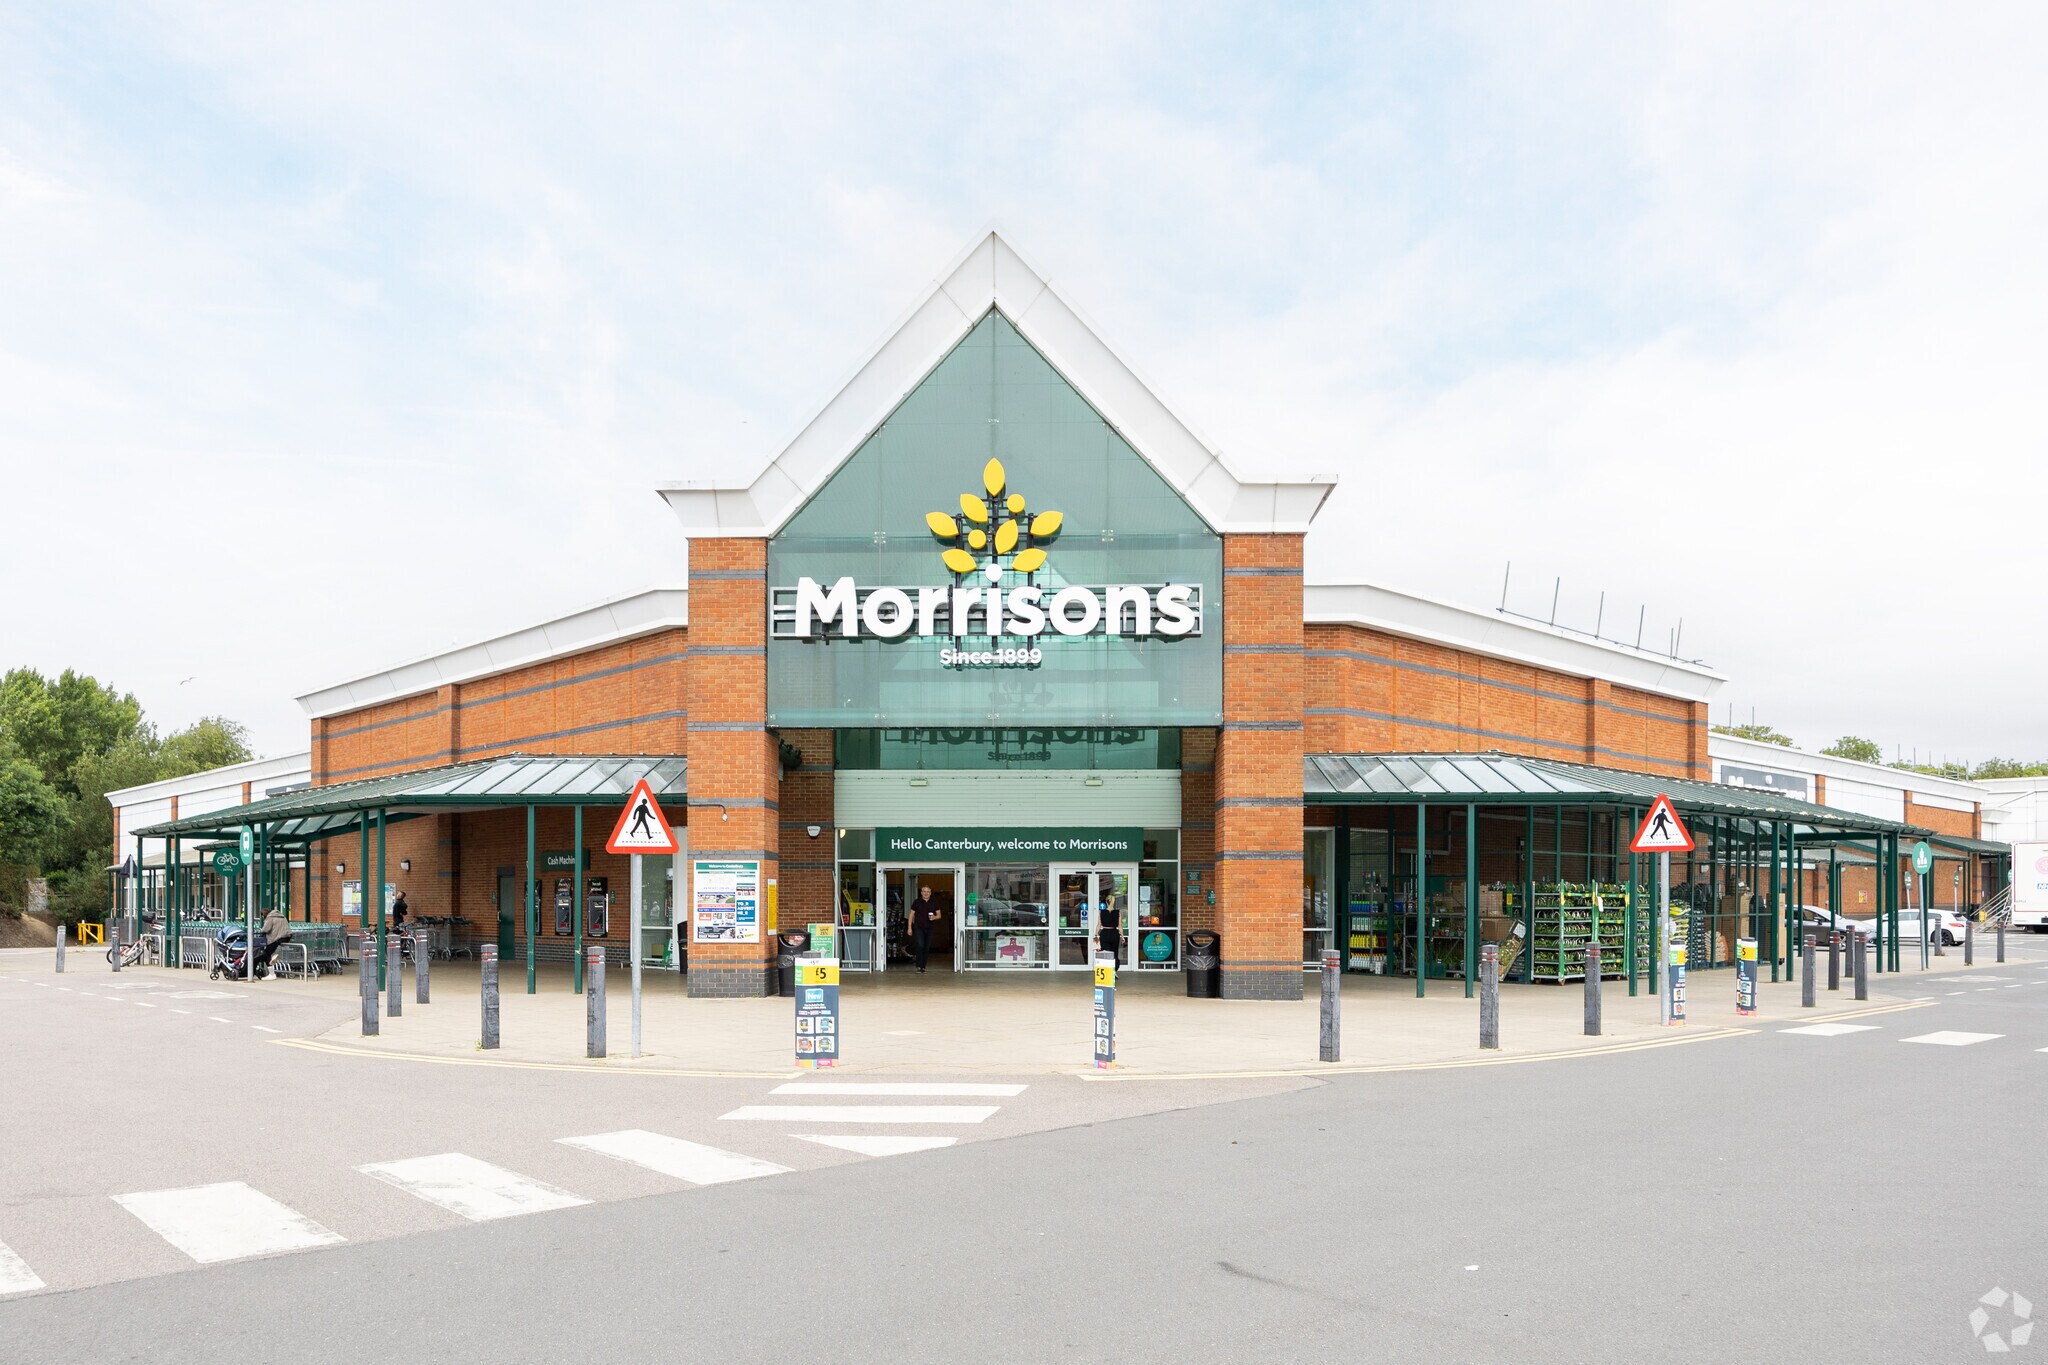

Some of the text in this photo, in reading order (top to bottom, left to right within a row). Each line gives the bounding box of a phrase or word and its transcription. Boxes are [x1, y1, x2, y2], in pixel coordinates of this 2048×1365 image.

[794, 563, 1197, 638] Morrisons
[939, 648, 1043, 666] Since 1899
[890, 838, 1128, 853] Hello Canterbury, welcome to Morrisons
[547, 855, 576, 866] Cash Machin
[815, 967, 827, 980] £5
[1096, 968, 1105, 980] £5
